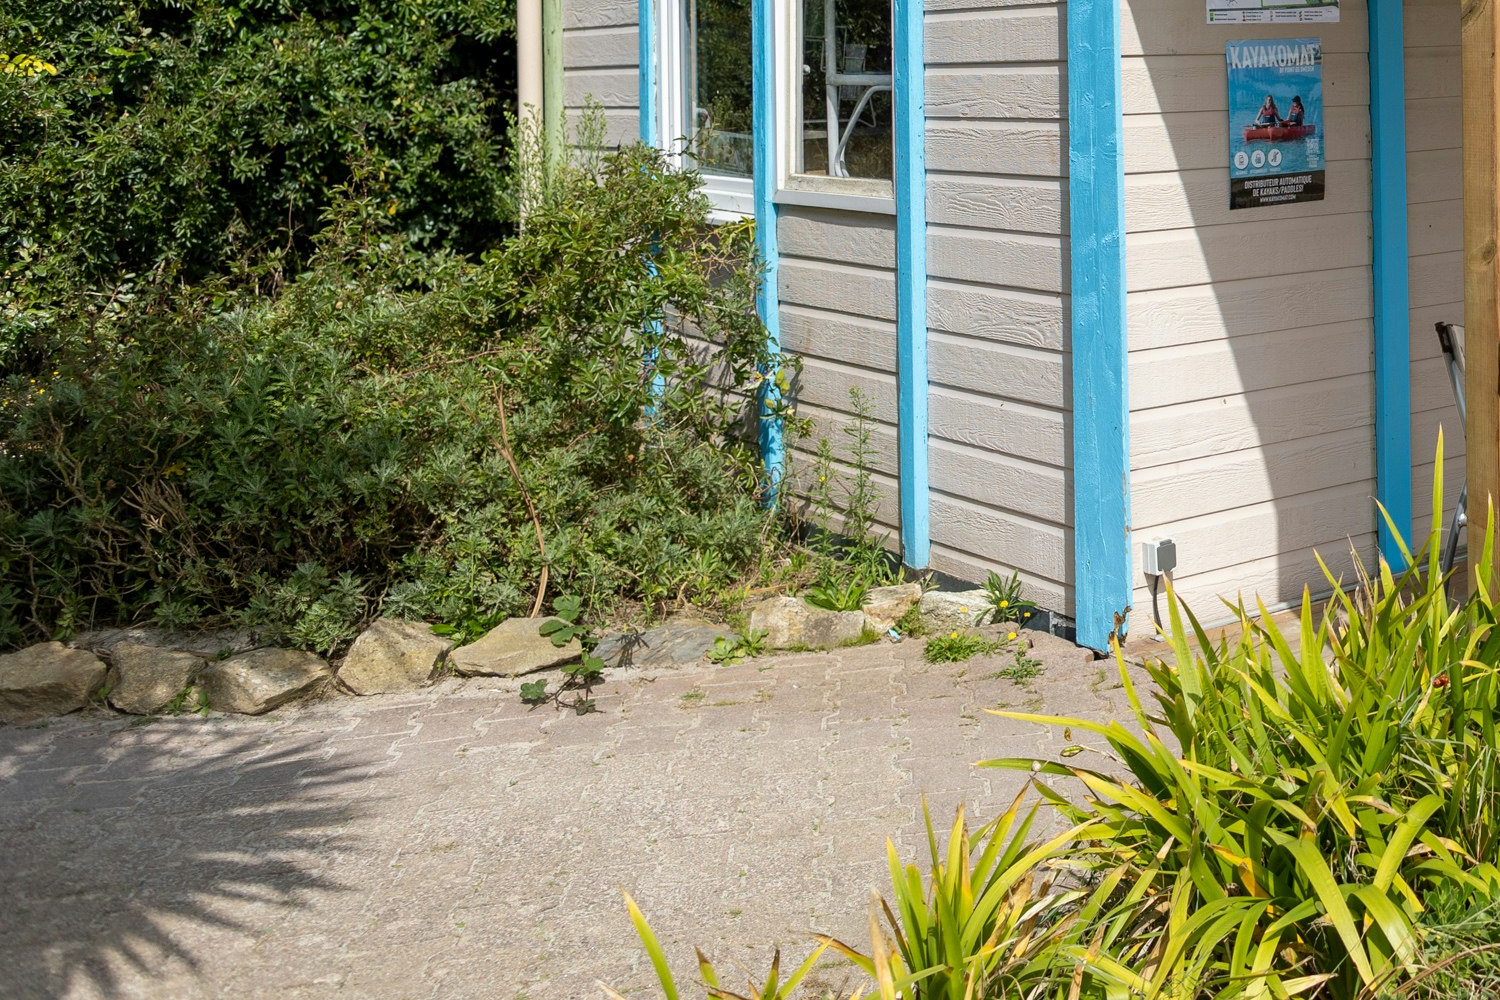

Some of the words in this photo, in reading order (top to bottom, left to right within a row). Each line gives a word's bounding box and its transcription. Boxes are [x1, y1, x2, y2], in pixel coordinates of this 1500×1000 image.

[1230, 44, 1315, 69] KAYAKOMAT
[1244, 178, 1279, 190] DISTRIBUTEUR
[1279, 175, 1312, 186] AUTOMATIQUE
[1252, 188, 1259, 197] DE
